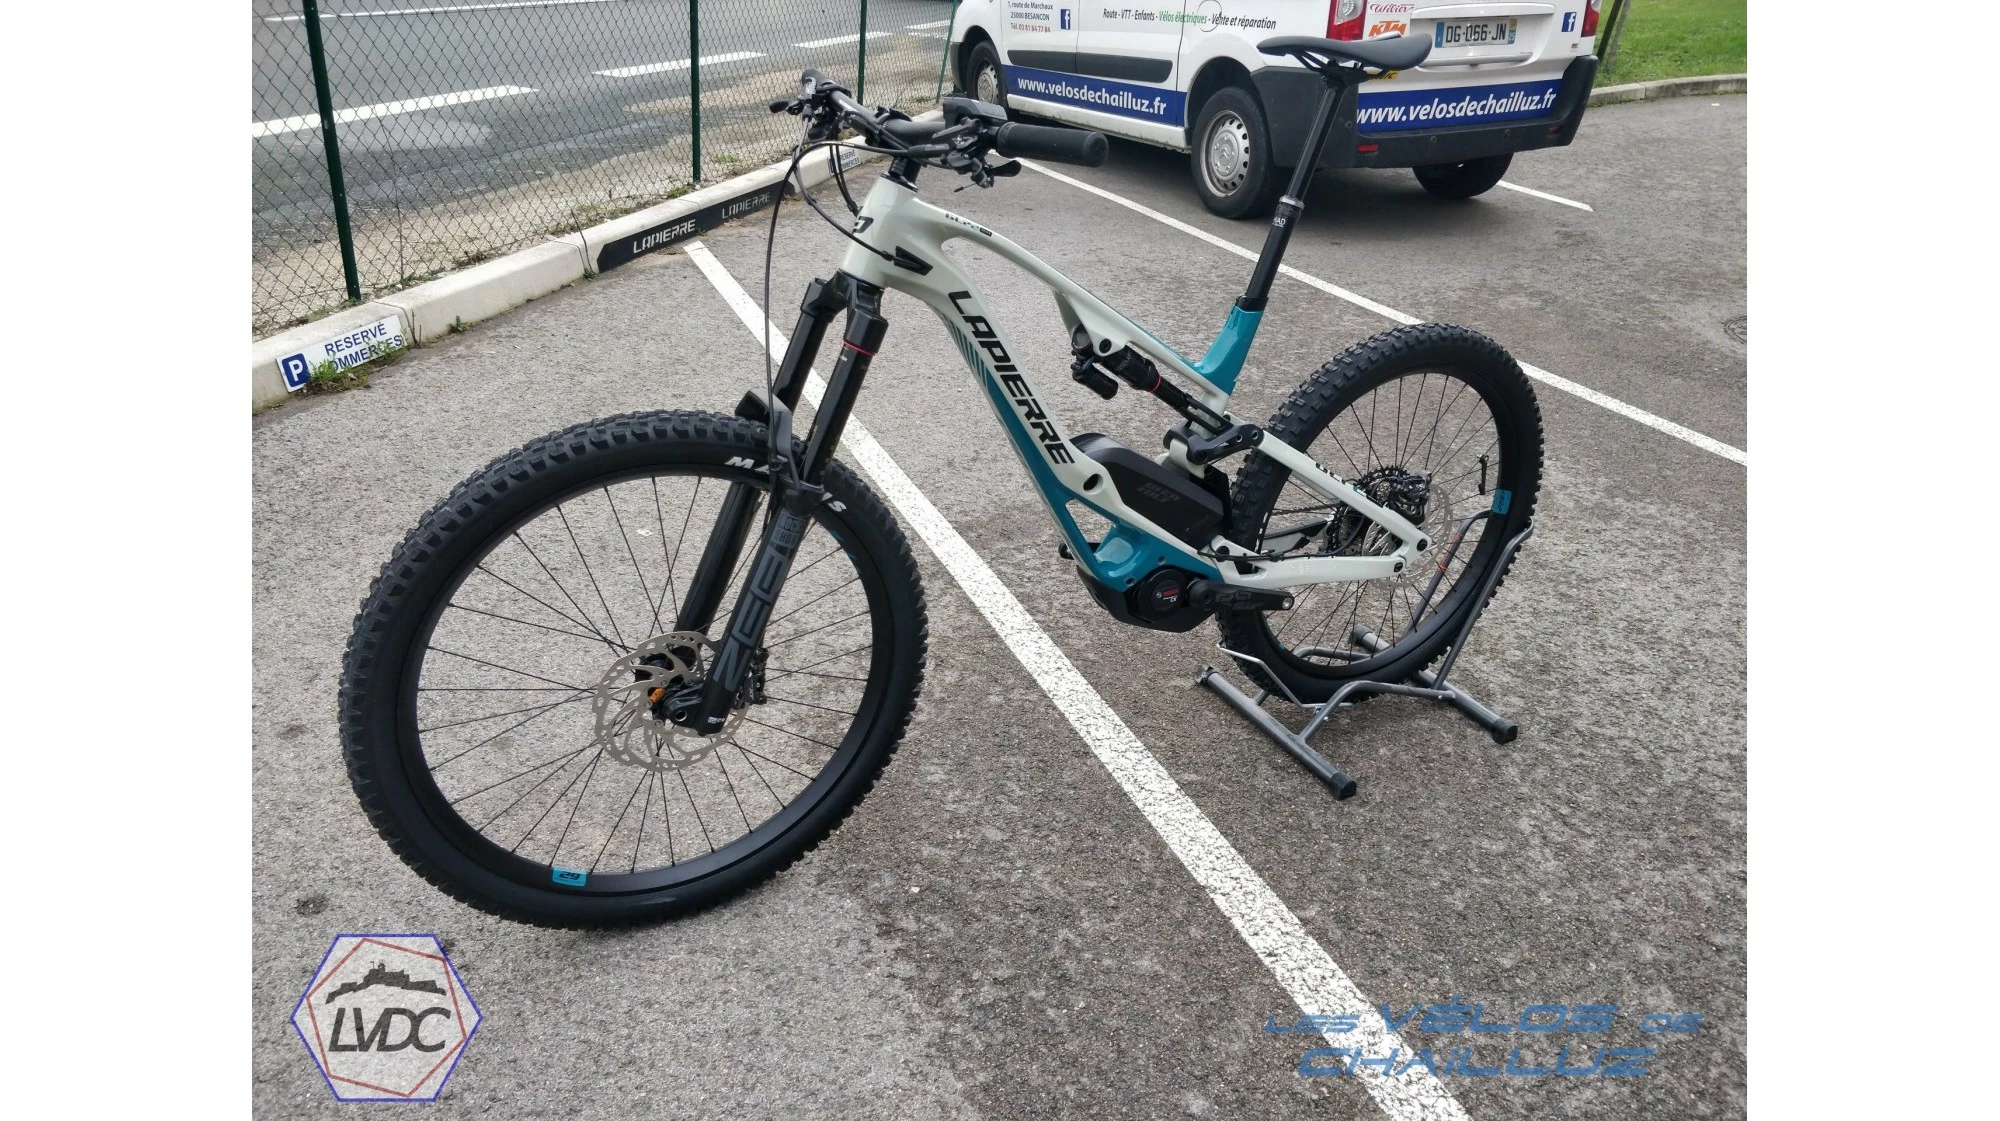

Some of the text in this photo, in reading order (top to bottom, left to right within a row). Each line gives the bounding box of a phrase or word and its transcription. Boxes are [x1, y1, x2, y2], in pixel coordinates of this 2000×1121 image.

[1103, 8, 1118, 19] Route
[1121, 9, 1131, 19] VTT
[1135, 10, 1155, 21] Enfants
[1212, 13, 1229, 26] Vente
[1230, 16, 1238, 26] et
[1237, 15, 1277, 30] réparation
[1368, 20, 1407, 37] KTM
[1018, 77, 1166, 115] www.velosdechailluz.fr
[1357, 88, 1557, 124] www.velosdechailluz.fr
[722, 192, 770, 219] LAPIERRE
[633, 219, 696, 254] LAPIERRE
[948, 291, 1075, 464] LAPIERRE
